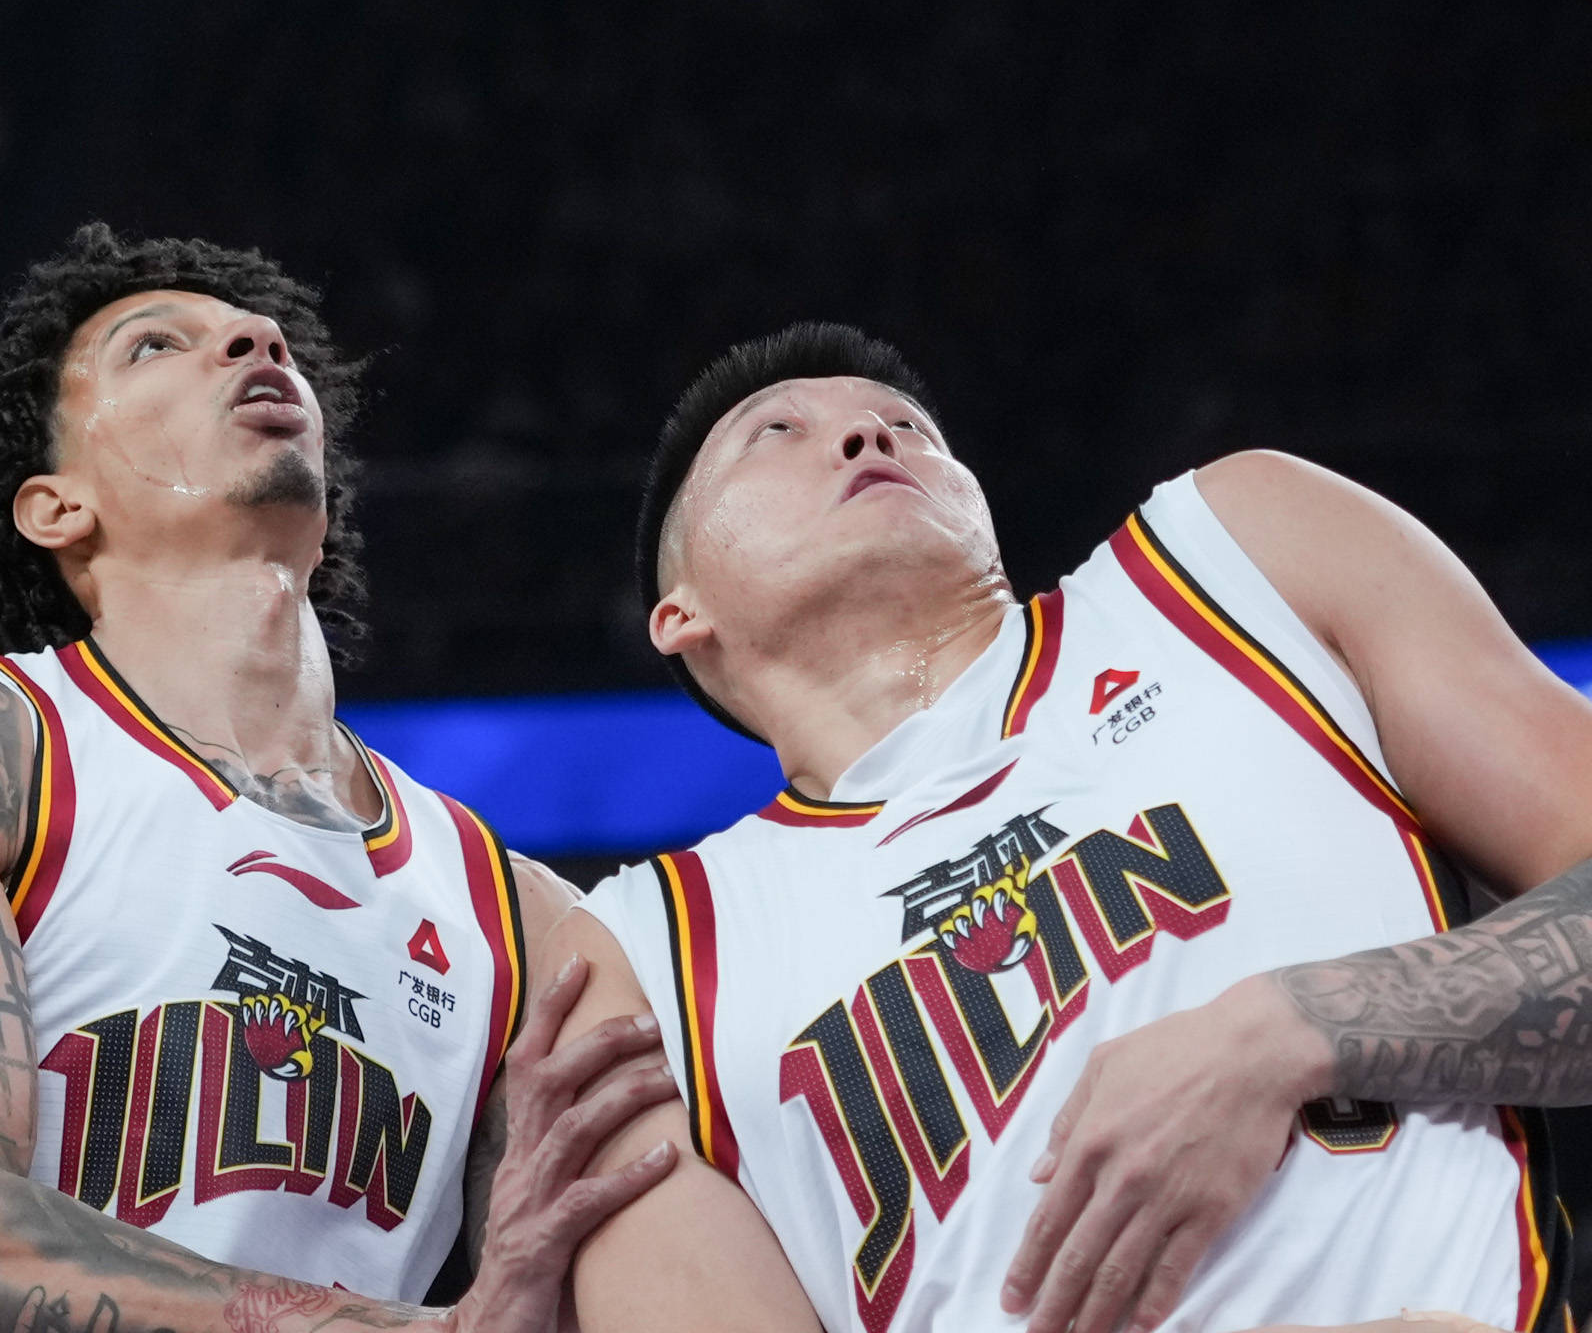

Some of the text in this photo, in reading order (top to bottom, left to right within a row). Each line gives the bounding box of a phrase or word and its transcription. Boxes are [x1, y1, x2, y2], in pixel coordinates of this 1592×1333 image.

[1091, 681, 1163, 746] 广发银行
[1111, 705, 1157, 745] CGB
[398, 969, 456, 1013] 广发银行
[407, 997, 442, 1029] CGB
[778, 801, 1232, 1333] JILIN
[38, 1000, 433, 1232] JILIN
